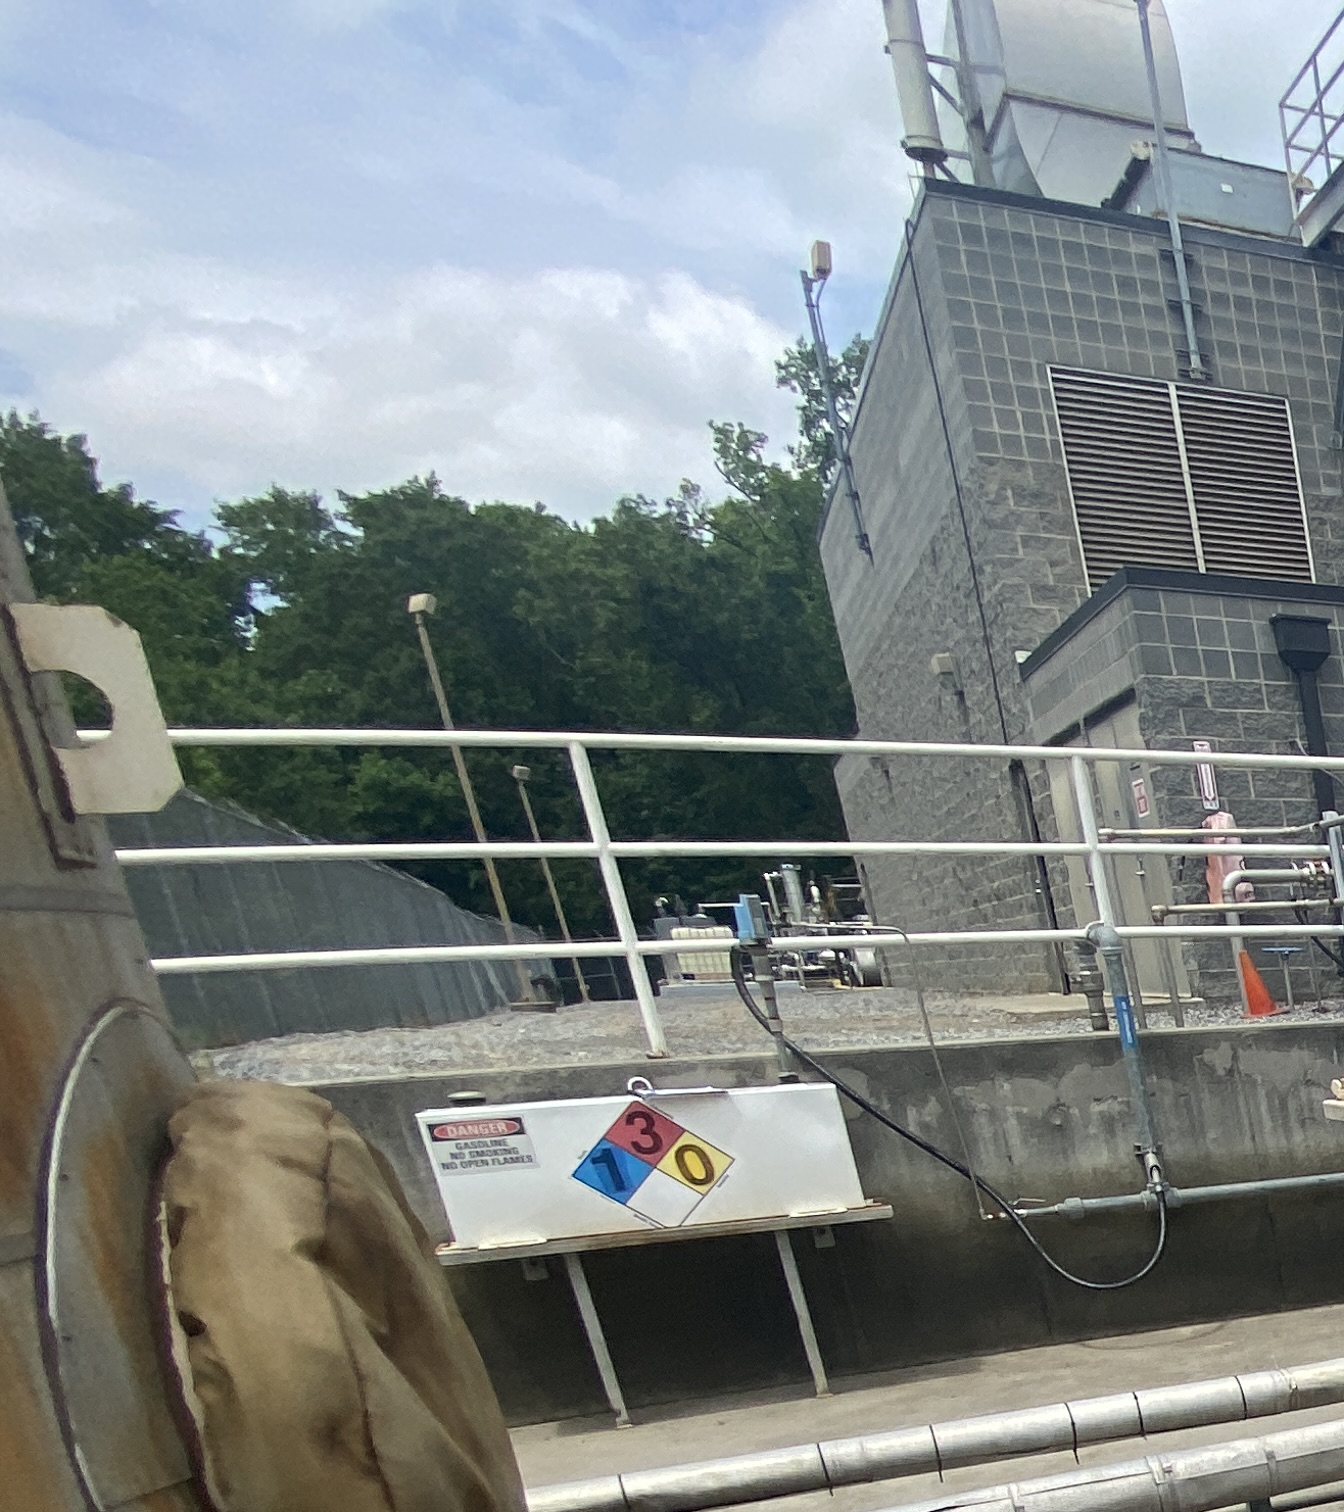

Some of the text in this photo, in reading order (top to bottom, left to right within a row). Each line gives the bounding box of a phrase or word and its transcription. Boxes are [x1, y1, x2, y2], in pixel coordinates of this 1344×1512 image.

[446, 1121, 509, 1137] DANGER
[625, 1110, 663, 1155] 3
[455, 1138, 509, 1151] GASOLINE
[449, 1147, 520, 1160] NO SMOKING
[441, 1154, 533, 1170] NO OPEN FLAMES
[590, 1143, 715, 1192] 1 0
